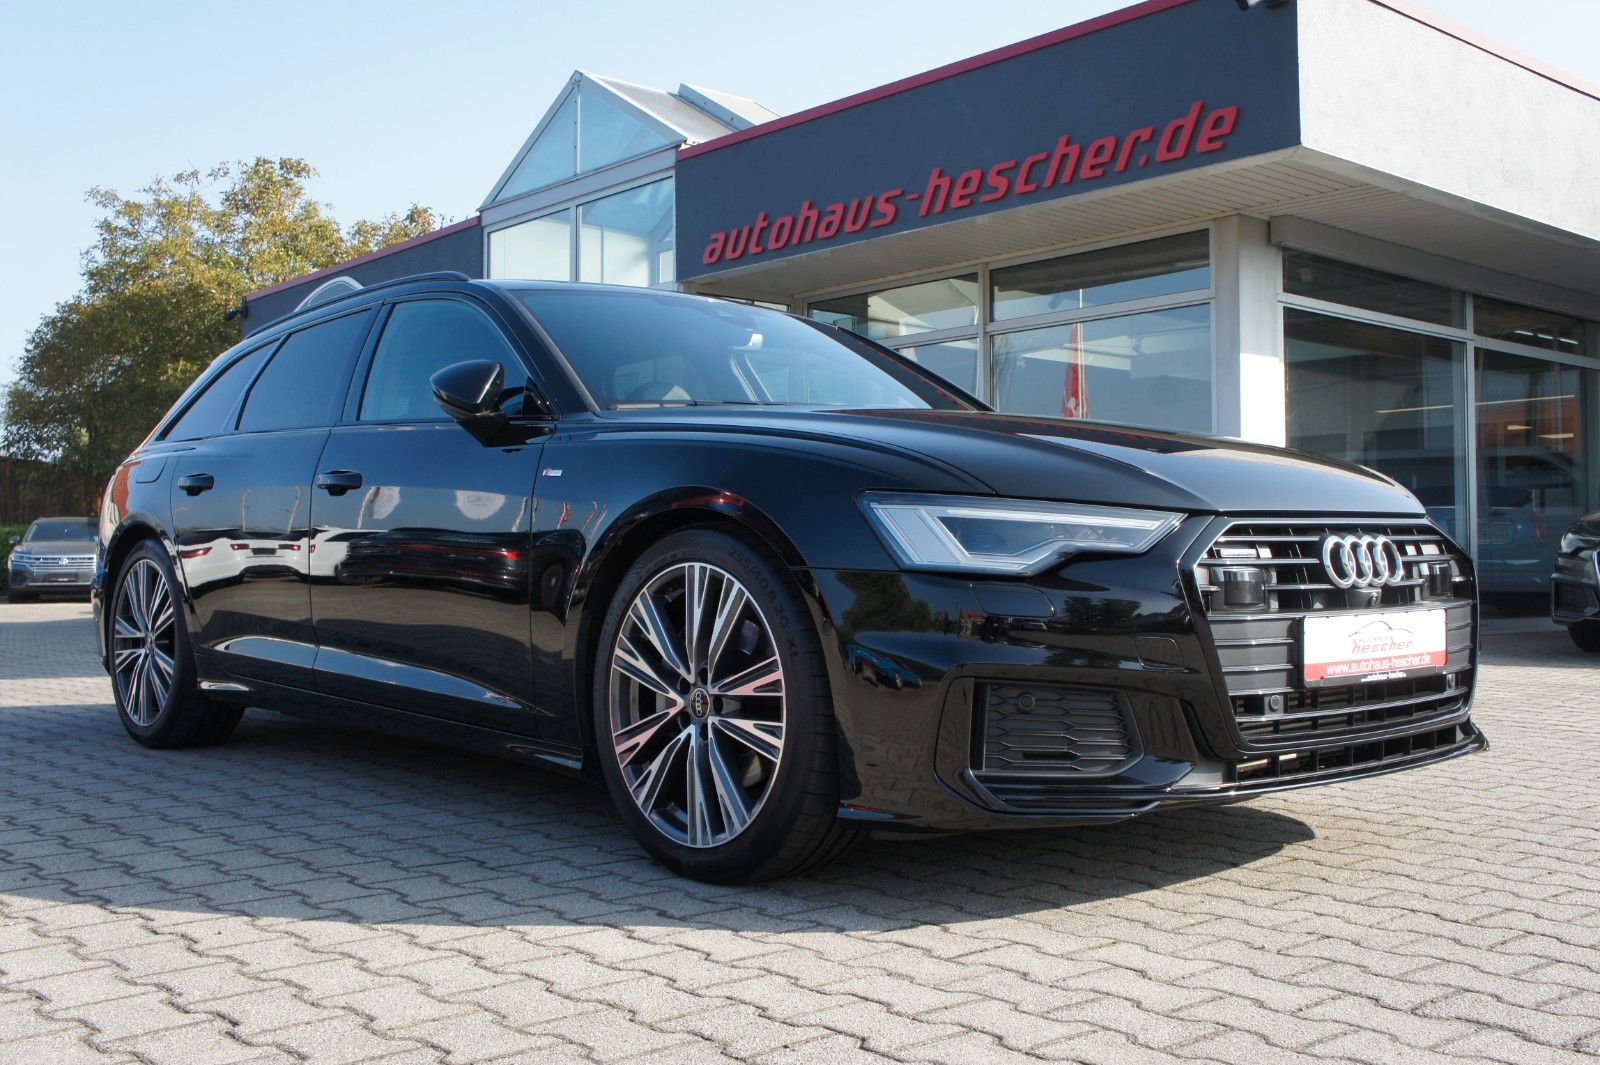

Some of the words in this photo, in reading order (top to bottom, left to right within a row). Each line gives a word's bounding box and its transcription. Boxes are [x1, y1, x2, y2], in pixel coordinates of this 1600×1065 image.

[702, 100, 1238, 264] autohaus-hescher.de
[1352, 638, 1413, 654] hescher
[1326, 653, 1431, 674] www.autohaus-hescher.de
